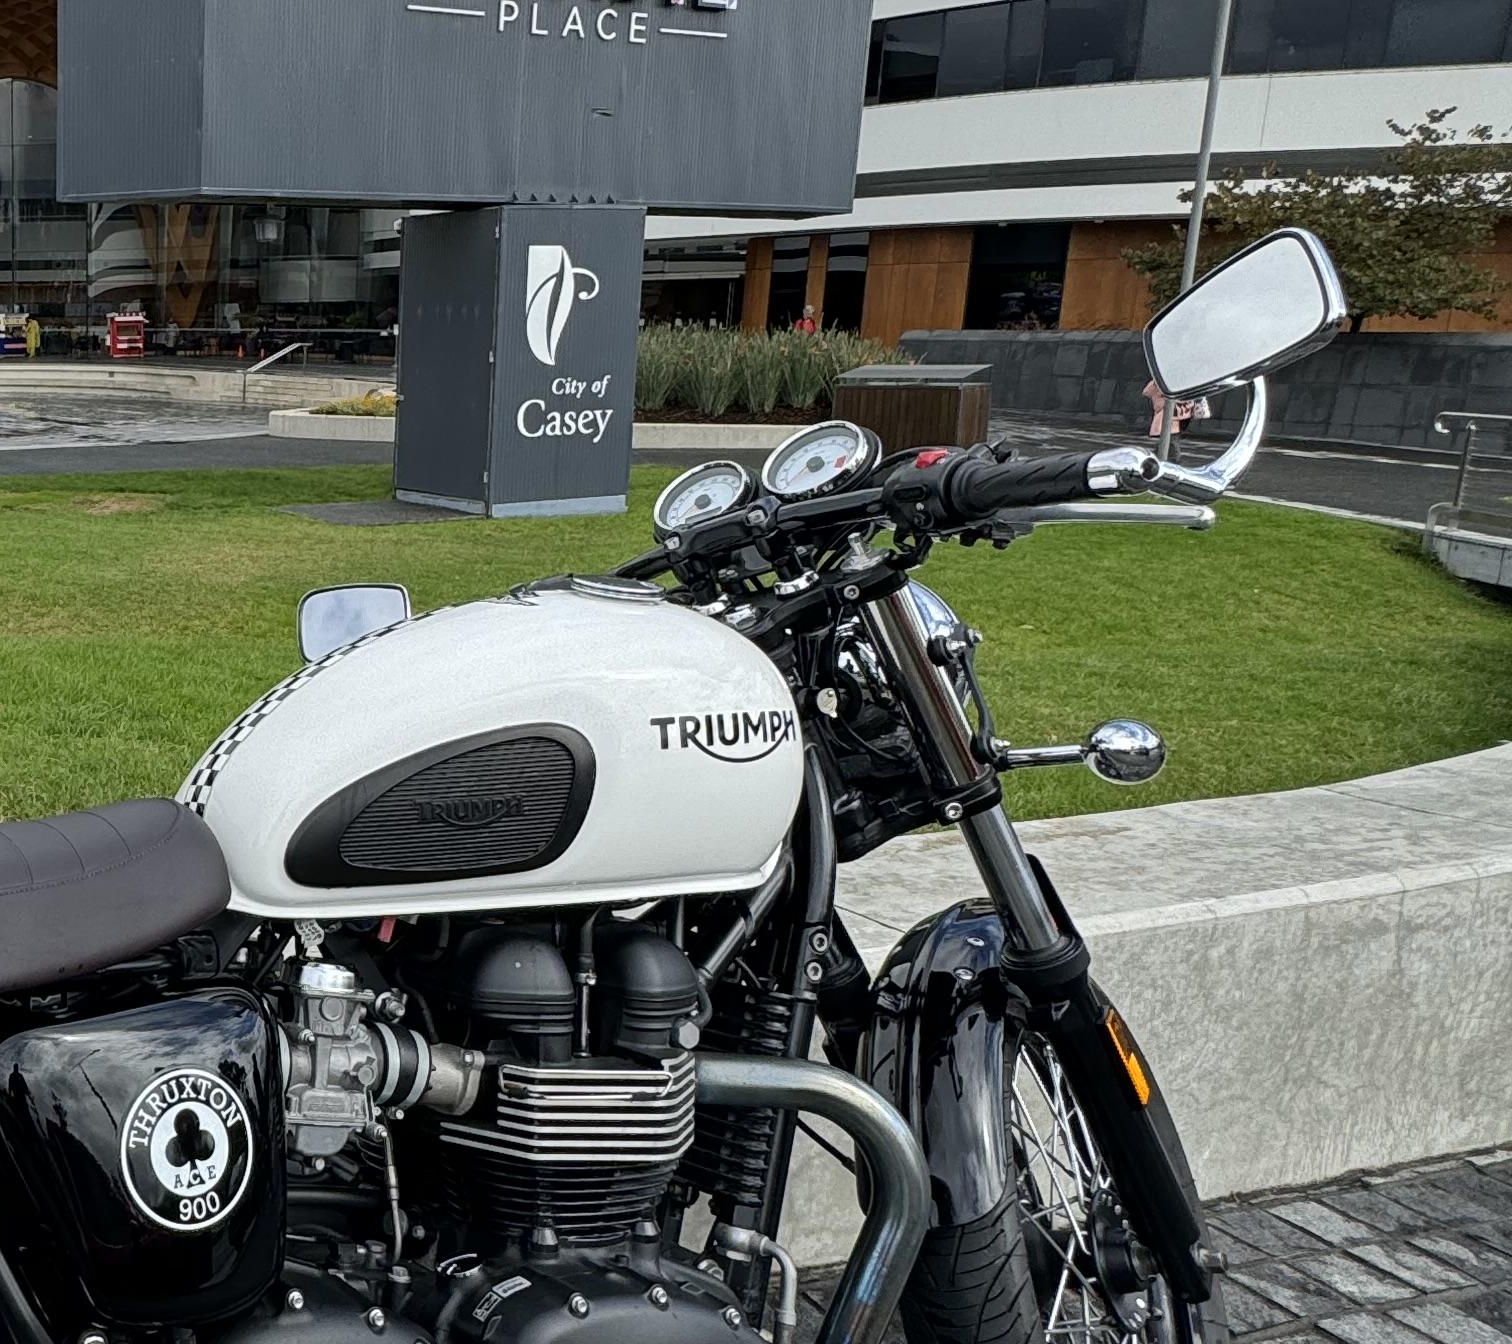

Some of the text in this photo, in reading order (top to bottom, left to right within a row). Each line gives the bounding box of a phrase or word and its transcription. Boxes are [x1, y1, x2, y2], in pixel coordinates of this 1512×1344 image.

[498, 0, 649, 44] PLACE
[551, 374, 611, 399] City of
[516, 398, 614, 444] Casey
[649, 709, 797, 763] TRIUMPH
[412, 796, 524, 825] TRIUMPH
[128, 1076, 243, 1150] THRUXTON
[173, 1164, 218, 1189] ACE
[178, 1191, 221, 1222] 900
